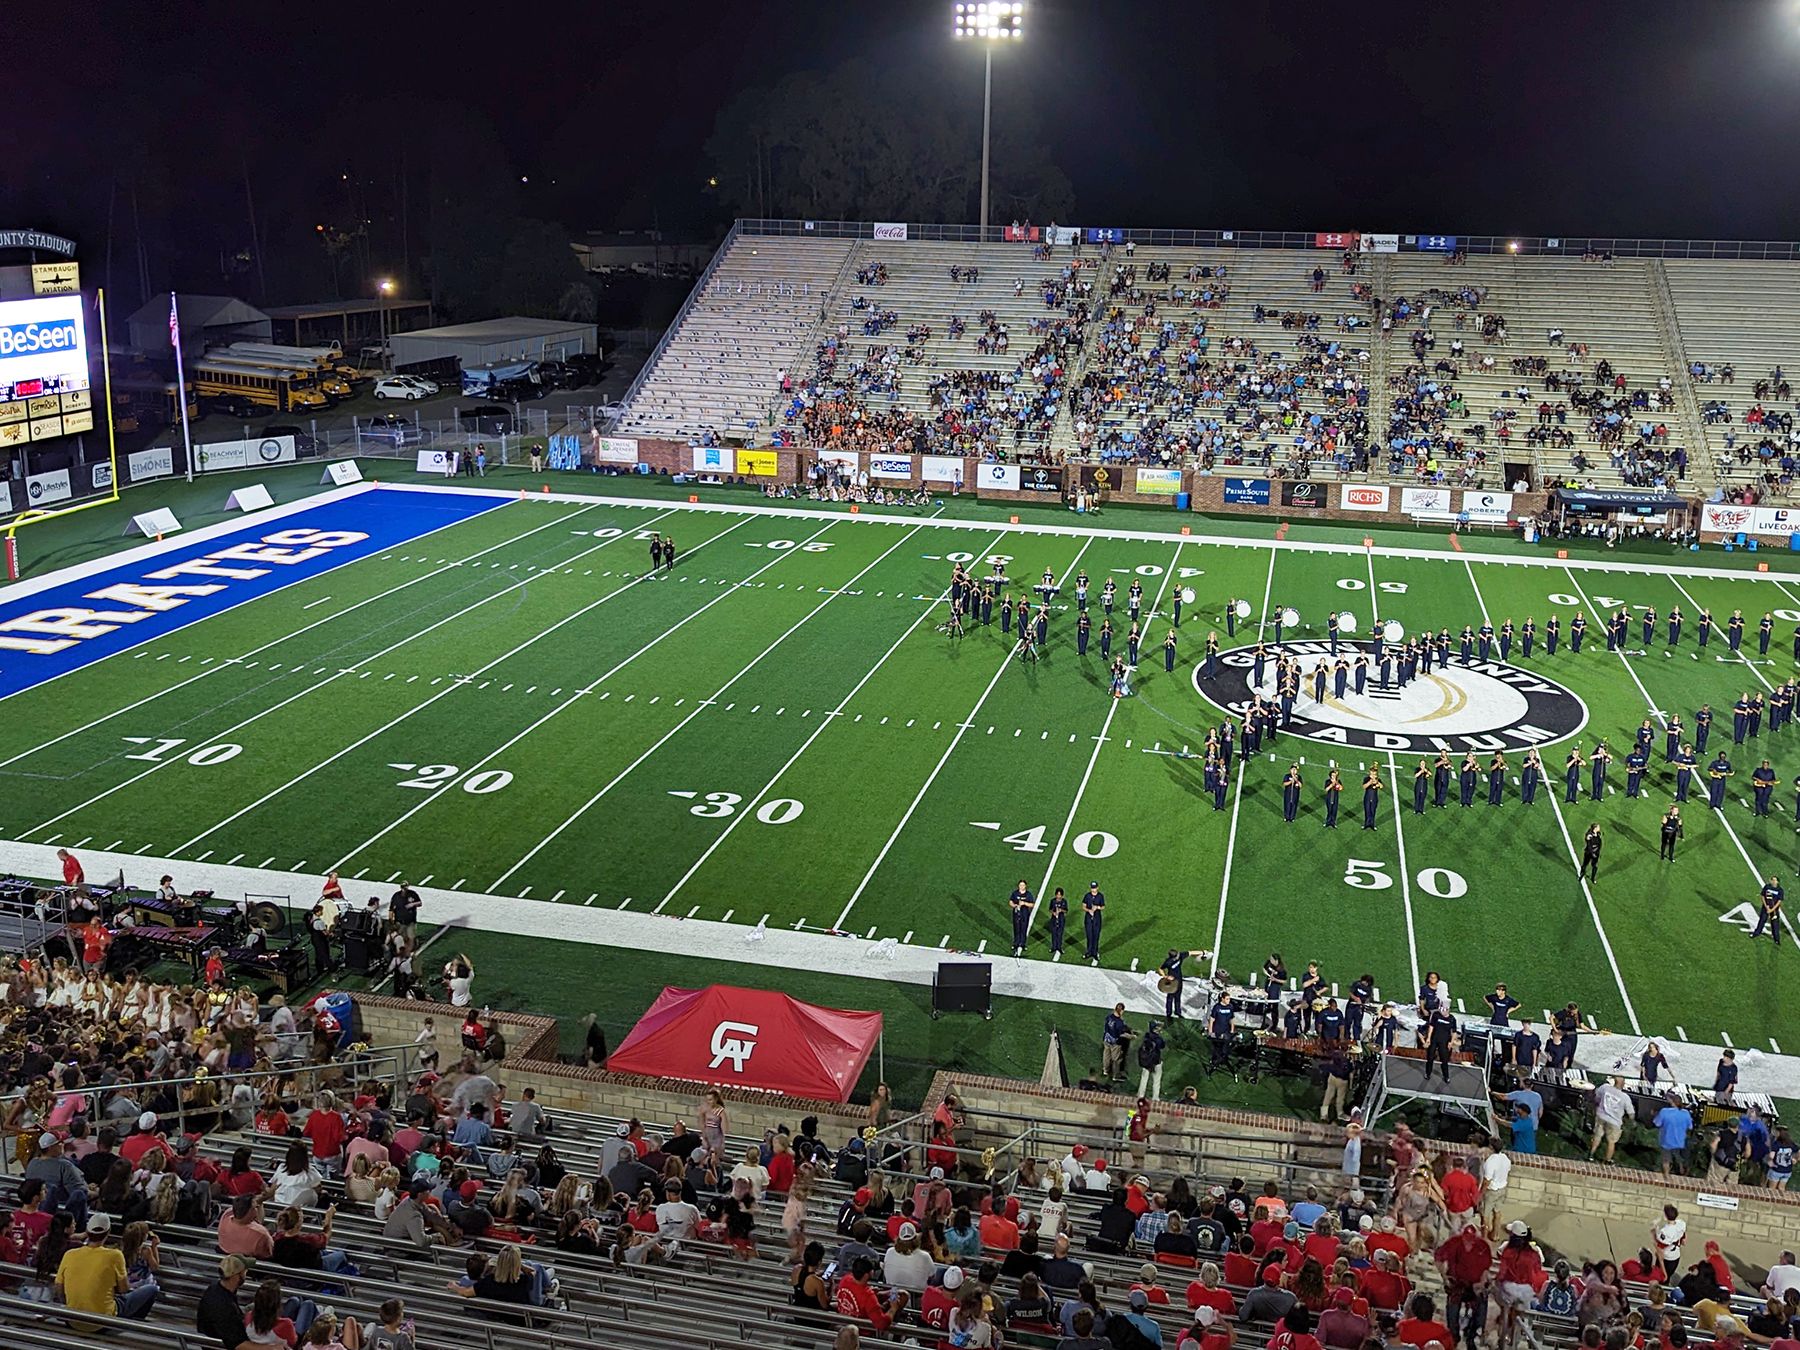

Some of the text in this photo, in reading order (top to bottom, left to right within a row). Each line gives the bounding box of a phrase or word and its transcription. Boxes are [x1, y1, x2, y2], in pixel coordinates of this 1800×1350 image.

[28, 233, 71, 254] STADIUM
[34, 265, 77, 273] STAMBAUGH
[42, 285, 73, 294] AVIATION
[0, 324, 76, 354] BeSeen
[210, 450, 243, 458] BEACHVIEW
[132, 458, 171, 474] SIMONE
[882, 461, 911, 472] BeSeen
[43, 480, 68, 492] Lifestyles
[1349, 491, 1382, 502] RICH'S
[1226, 700, 1559, 753] SADIUM
[1042, 1207, 1063, 1217] COSTA
